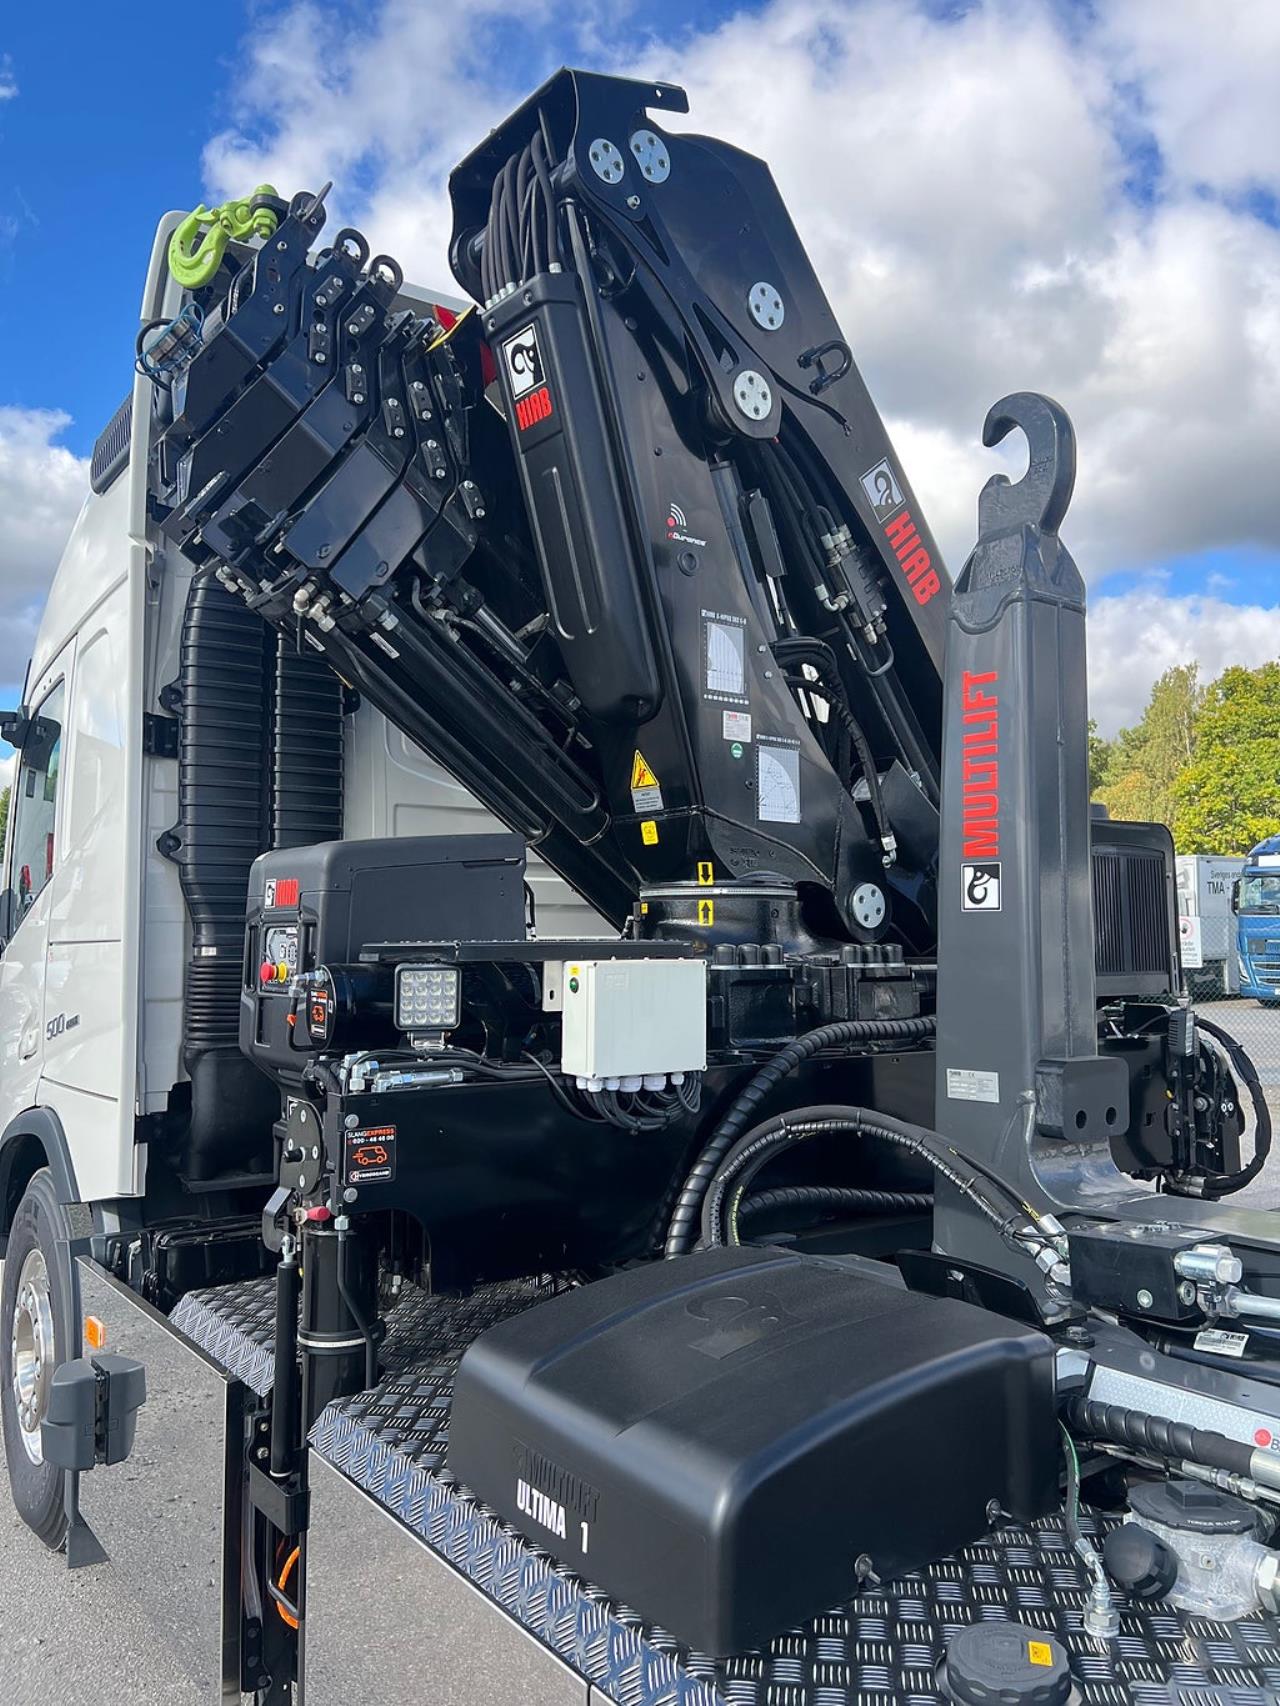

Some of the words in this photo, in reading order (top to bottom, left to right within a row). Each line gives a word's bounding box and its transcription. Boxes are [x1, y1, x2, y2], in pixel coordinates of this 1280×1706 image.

[516, 387, 552, 431] HIAB
[885, 511, 940, 605] HIAB
[962, 671, 999, 857] MULTILIFT
[1207, 882, 1225, 895] TMA
[46, 1013, 65, 1040] 500
[516, 1478, 567, 1540] ULTIMA
[580, 1521, 589, 1554] 1
